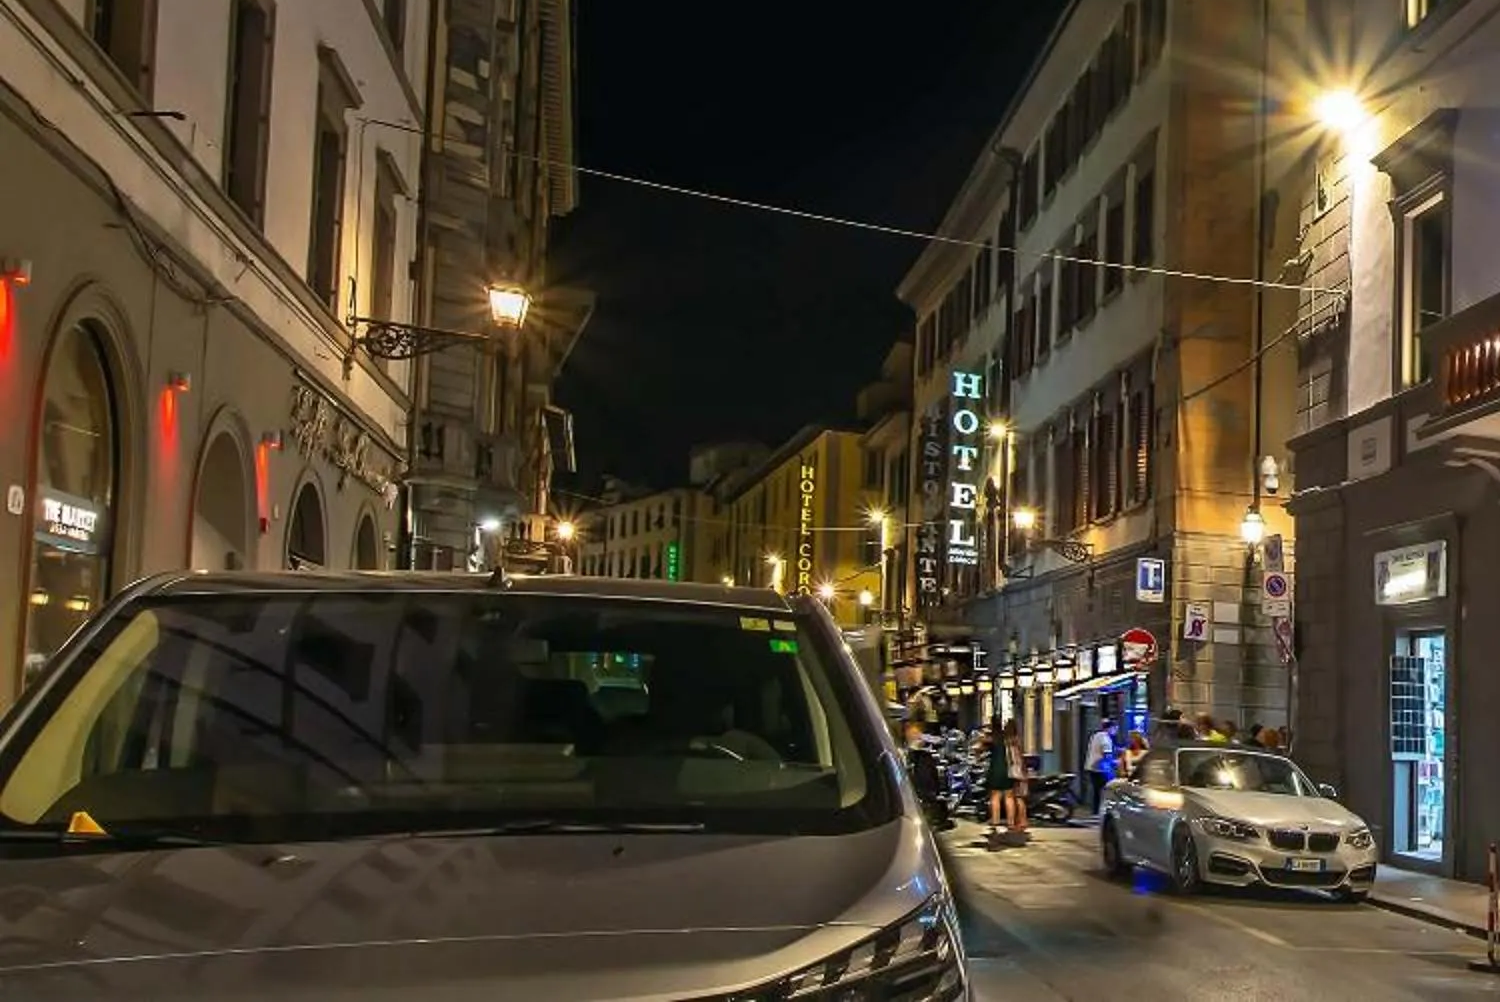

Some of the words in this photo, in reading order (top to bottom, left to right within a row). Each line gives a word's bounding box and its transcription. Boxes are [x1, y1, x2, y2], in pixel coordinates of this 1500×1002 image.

[800, 465, 814, 536] HOTEL
[920, 401, 942, 593] ISTOANTE
[950, 371, 982, 546] HOTEL
